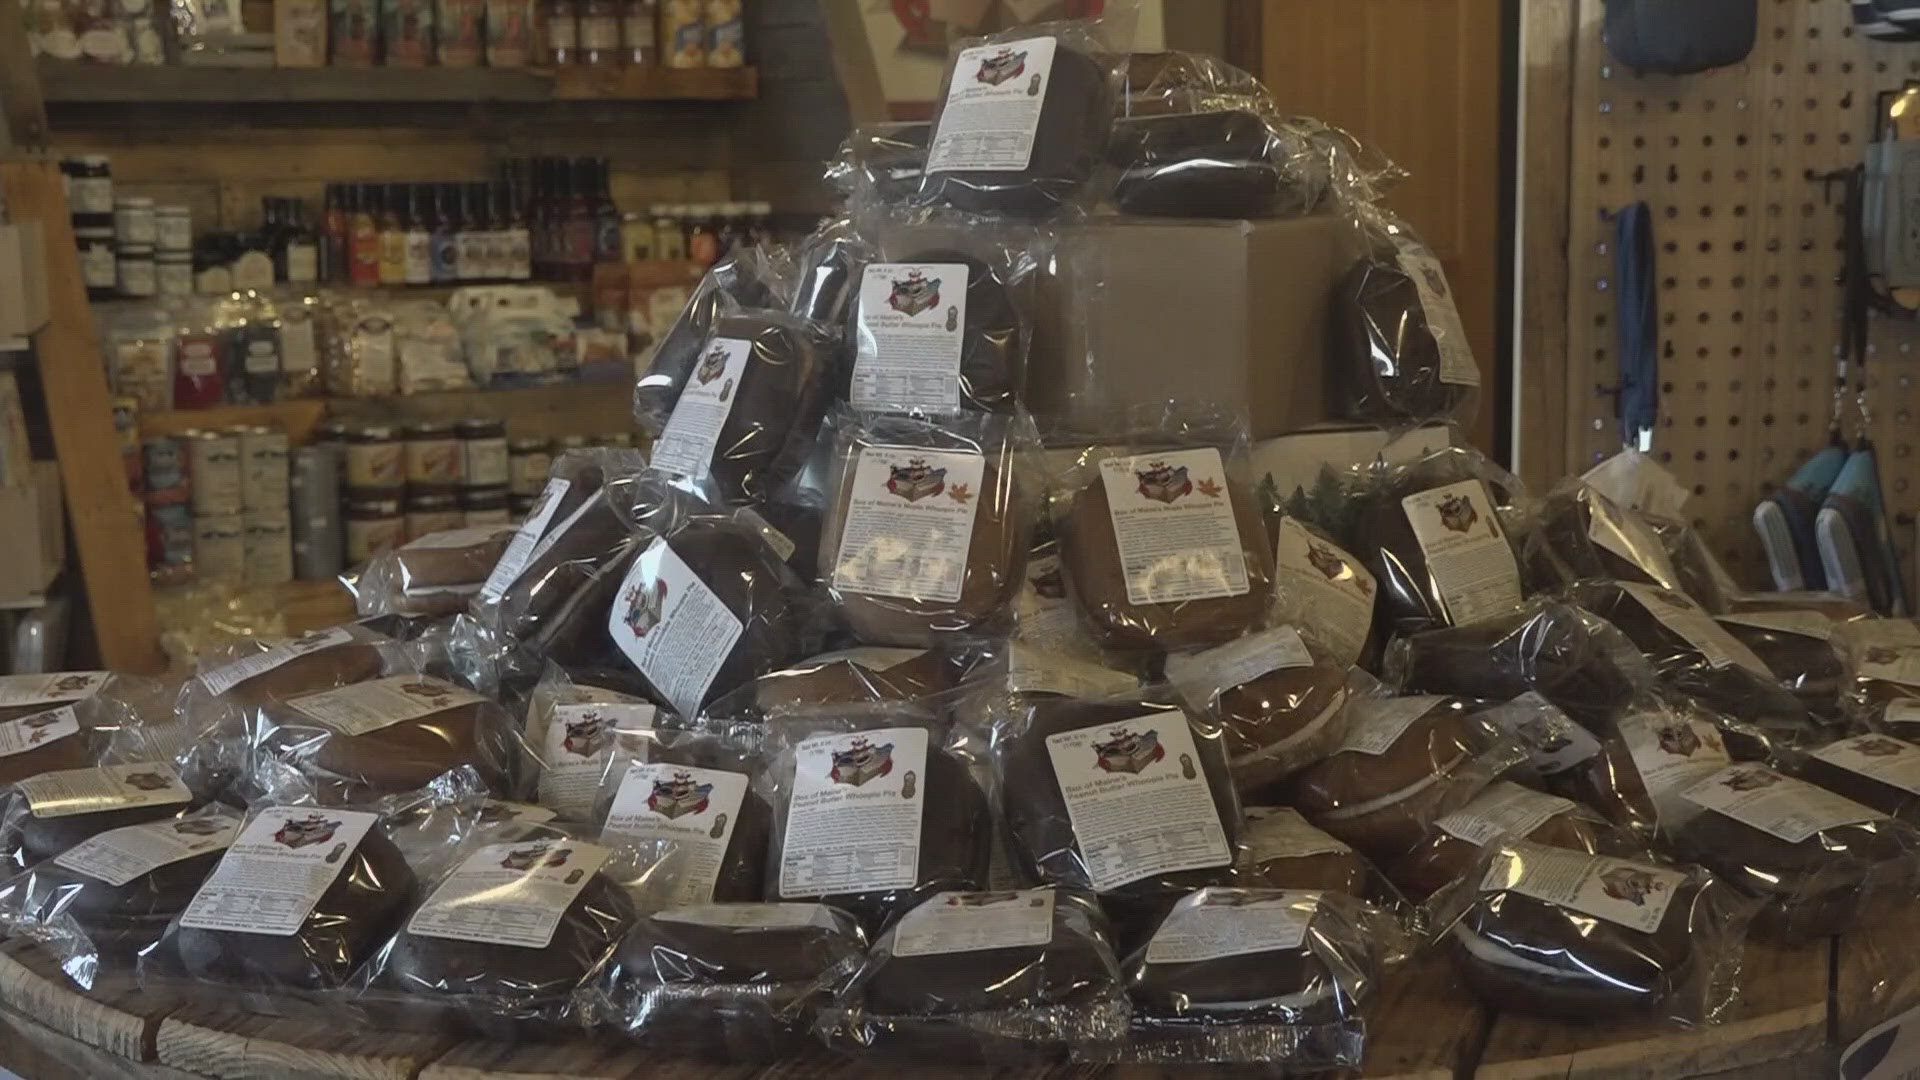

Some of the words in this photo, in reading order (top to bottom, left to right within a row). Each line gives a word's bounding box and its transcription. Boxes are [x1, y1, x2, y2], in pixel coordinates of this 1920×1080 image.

[1067, 788, 1097, 800] Peanut
[1098, 782, 1124, 793] Butter
[1126, 774, 1164, 788] Whoopie
[1164, 771, 1178, 781] Pie
[1094, 774, 1127, 787] Maine's
[792, 799, 819, 808] Peanut
[820, 795, 842, 803] Butter
[845, 790, 881, 801] Whoopie
